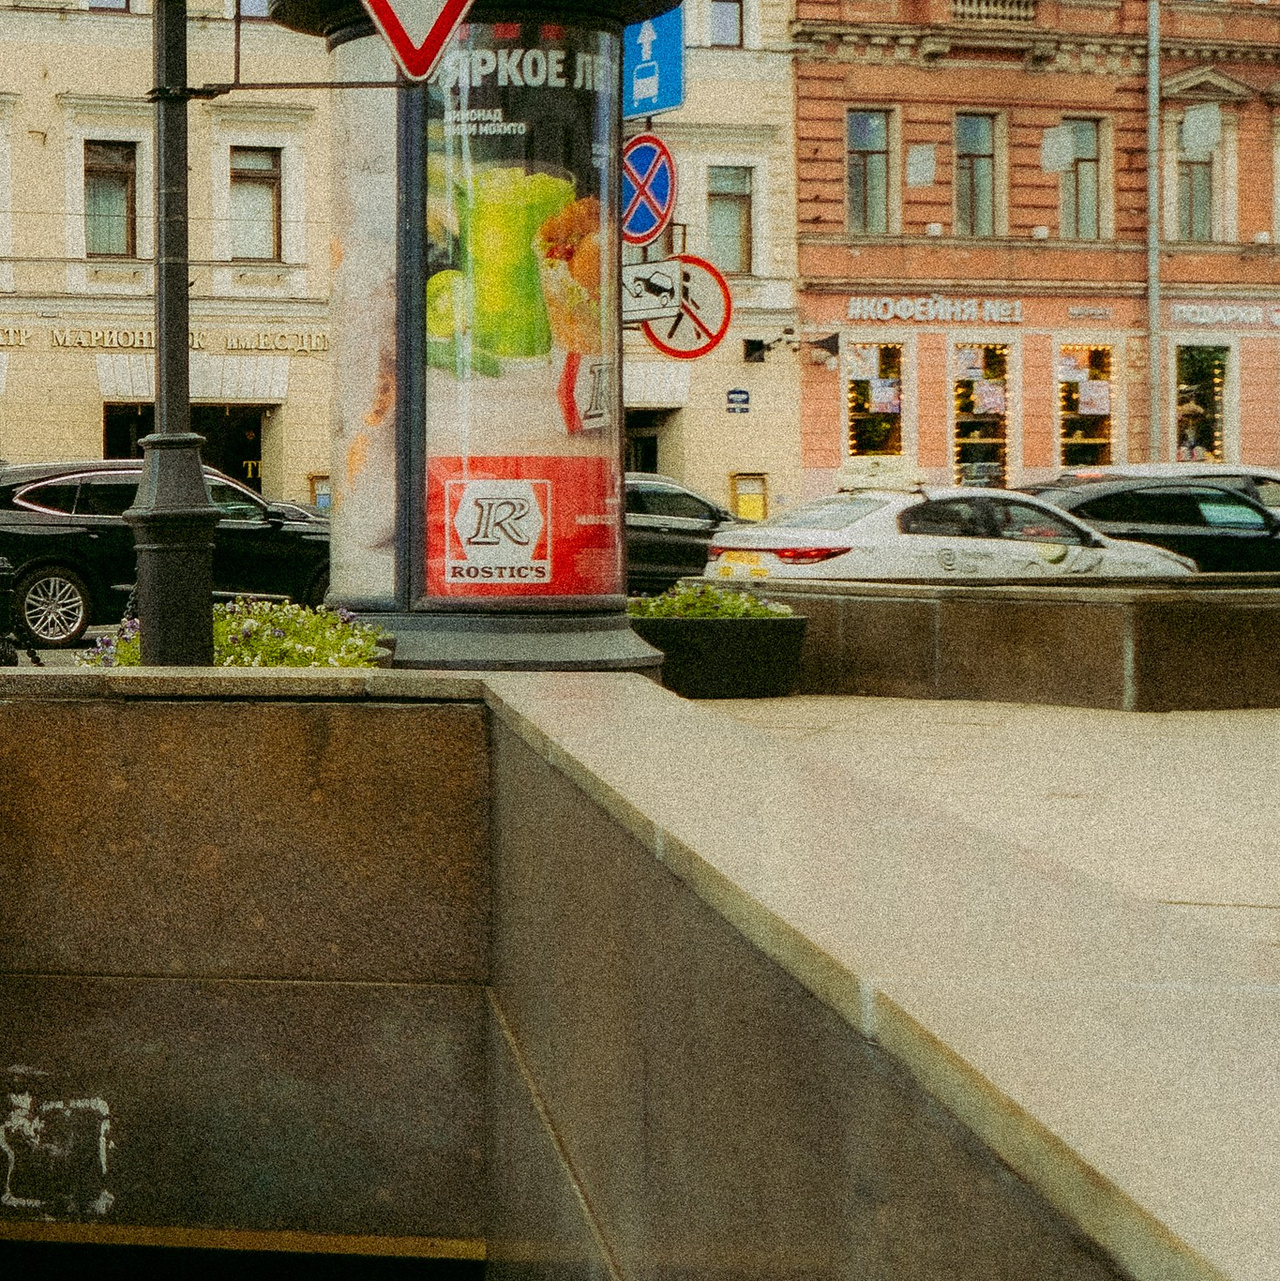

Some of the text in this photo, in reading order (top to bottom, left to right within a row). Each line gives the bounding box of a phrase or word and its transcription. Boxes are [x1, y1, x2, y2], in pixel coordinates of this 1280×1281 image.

[444, 48, 567, 88] ЯРКОЕ
[848, 294, 1022, 323] #КОФЕЙНЯ №1
[51, 329, 207, 351] МАРИОНК
[451, 565, 547, 580] ROSTIC'S
